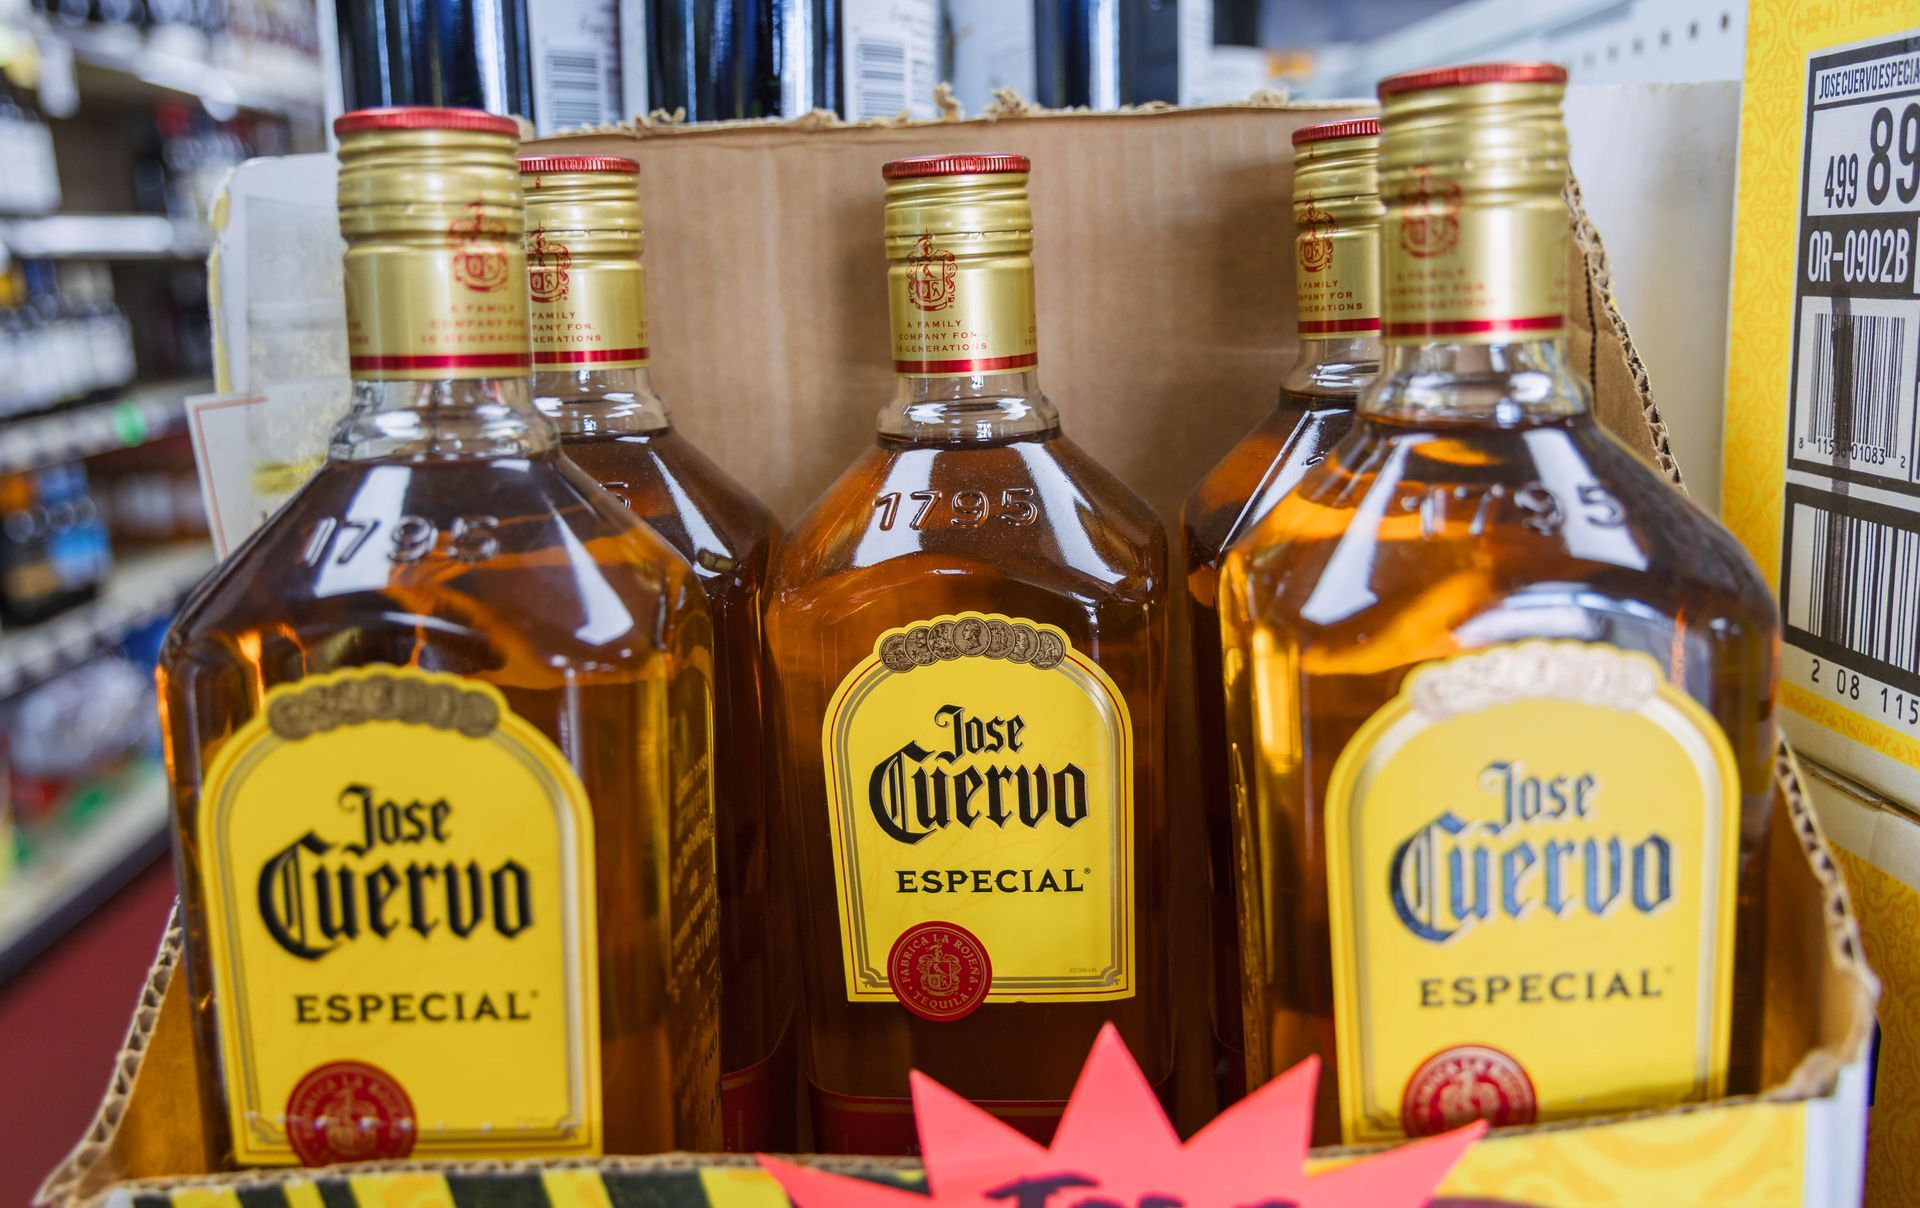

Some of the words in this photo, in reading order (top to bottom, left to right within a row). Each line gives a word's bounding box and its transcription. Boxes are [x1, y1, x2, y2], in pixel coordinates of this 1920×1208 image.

[1824, 153, 1859, 208] 499
[1807, 228, 1910, 283] OR-0902B
[1330, 291, 1353, 300] FOR
[533, 334, 602, 344] NERATIONS
[567, 322, 592, 331] FOR
[899, 332, 947, 341] COMPANY
[905, 343, 988, 353] GENERATIOS
[917, 320, 962, 329] FAMILY
[1900, 455, 1906, 469] 2
[872, 487, 1038, 532] 1795
[302, 515, 499, 566] 1795
[1811, 658, 1821, 683] 2
[1836, 668, 1860, 701] 08
[1880, 687, 1920, 725] 115
[934, 704, 1026, 765] Jose
[868, 740, 1089, 845] Cuervo
[1479, 761, 1595, 834] Jose
[337, 783, 453, 858] Jose
[257, 829, 533, 961] Cuervo
[1388, 810, 1673, 945] Cuervo
[912, 990, 969, 1012] TEQUILA
